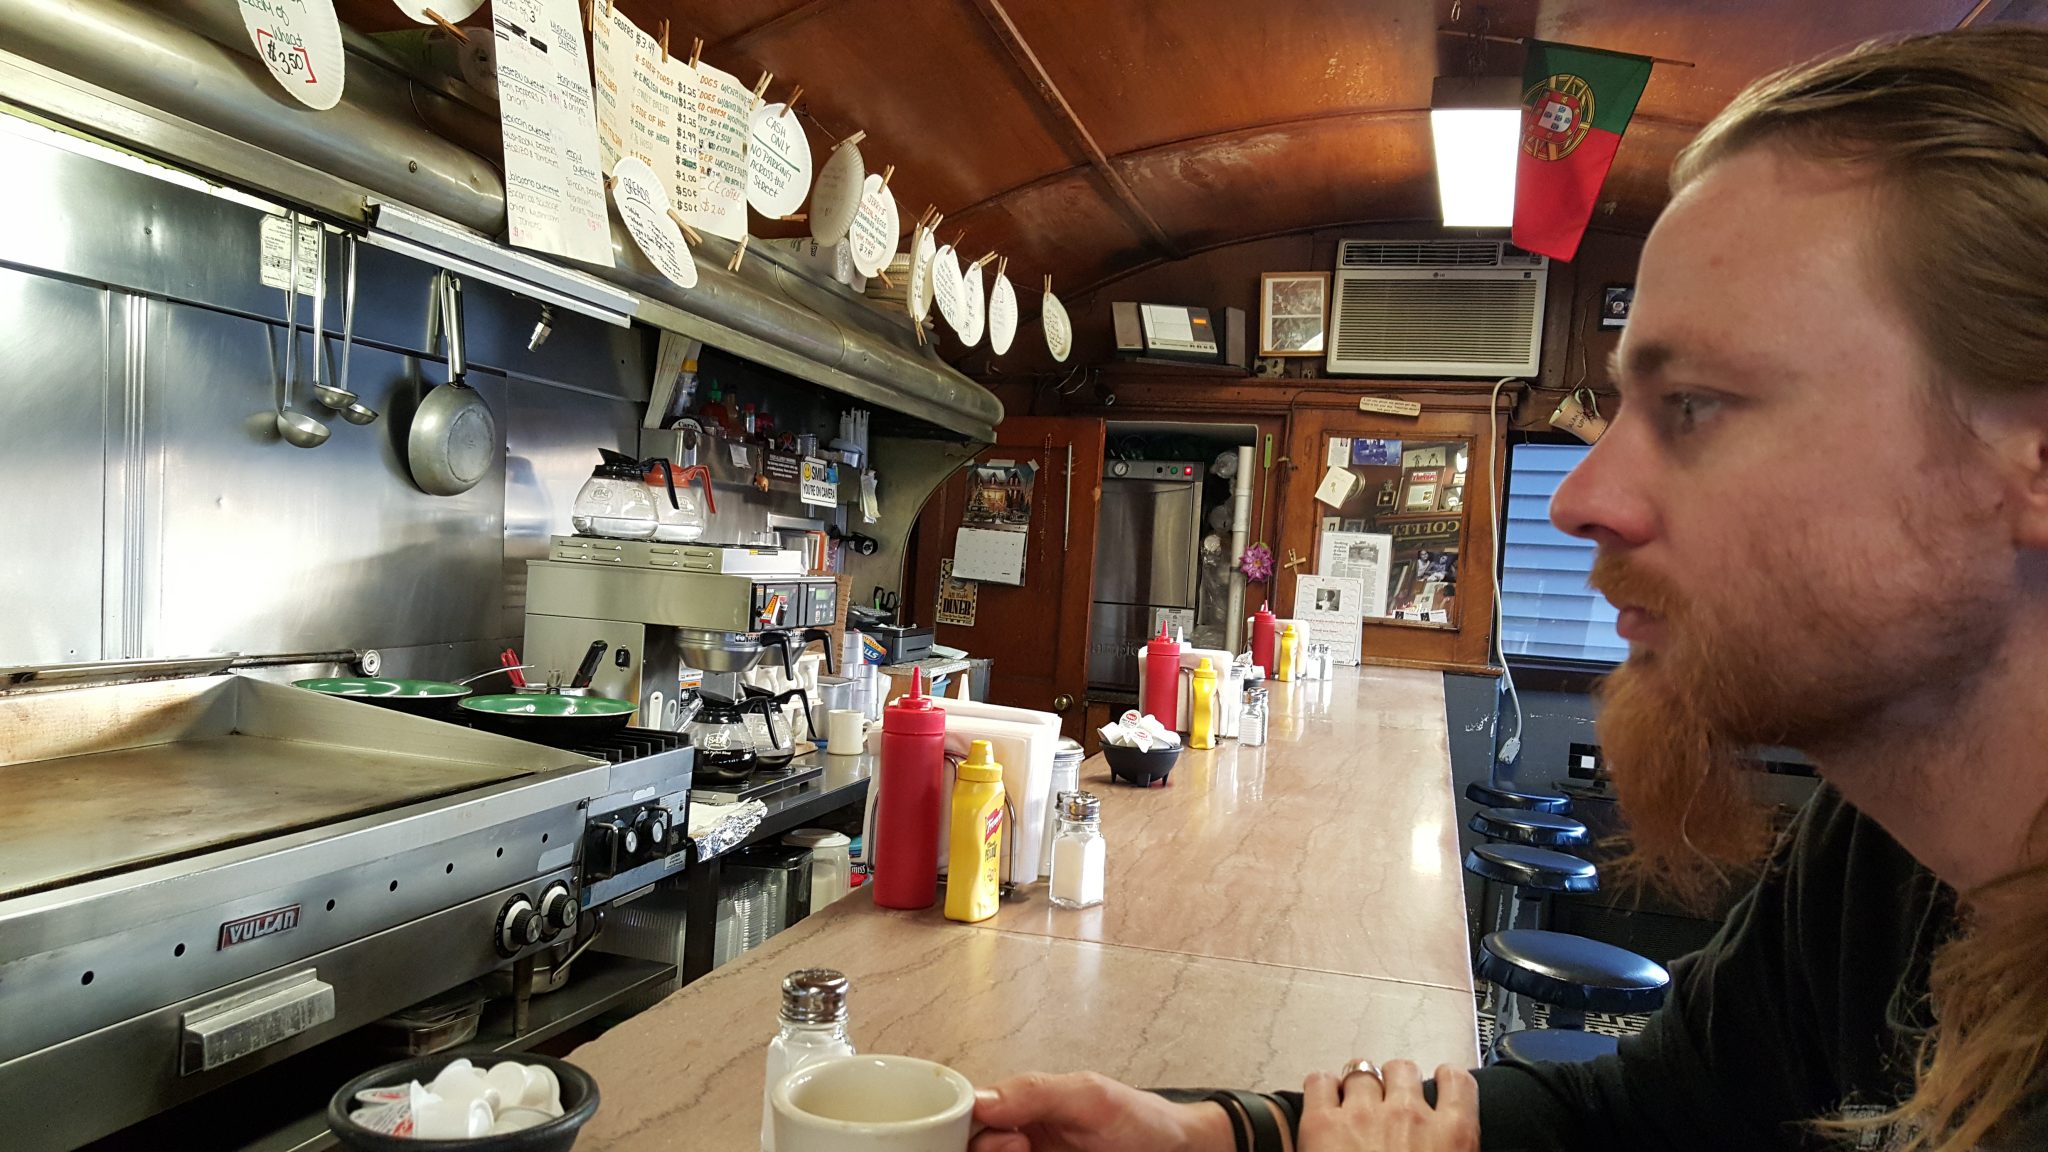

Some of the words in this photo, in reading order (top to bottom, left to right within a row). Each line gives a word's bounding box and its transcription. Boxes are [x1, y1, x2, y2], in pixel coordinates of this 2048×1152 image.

[613, 16, 634, 39] ORDERS
[635, 32, 656, 56] $3.49
[266, 40, 304, 75] $3.50
[677, 80, 697, 99] $1.25
[700, 75, 719, 89] DOGS
[659, 89, 679, 105] MUFFIN
[678, 97, 697, 113] $1.25
[677, 111, 697, 128] $1.25
[765, 117, 787, 139] CASH
[676, 127, 697, 143] $1.99
[770, 133, 791, 156] ONLY
[675, 140, 698, 156] $5.49
[750, 143, 762, 159] NO
[675, 169, 697, 183] $1.00
[750, 159, 774, 182] ACROSS
[942, 597, 973, 616] DINER
[229, 910, 296, 944] VULCAN
